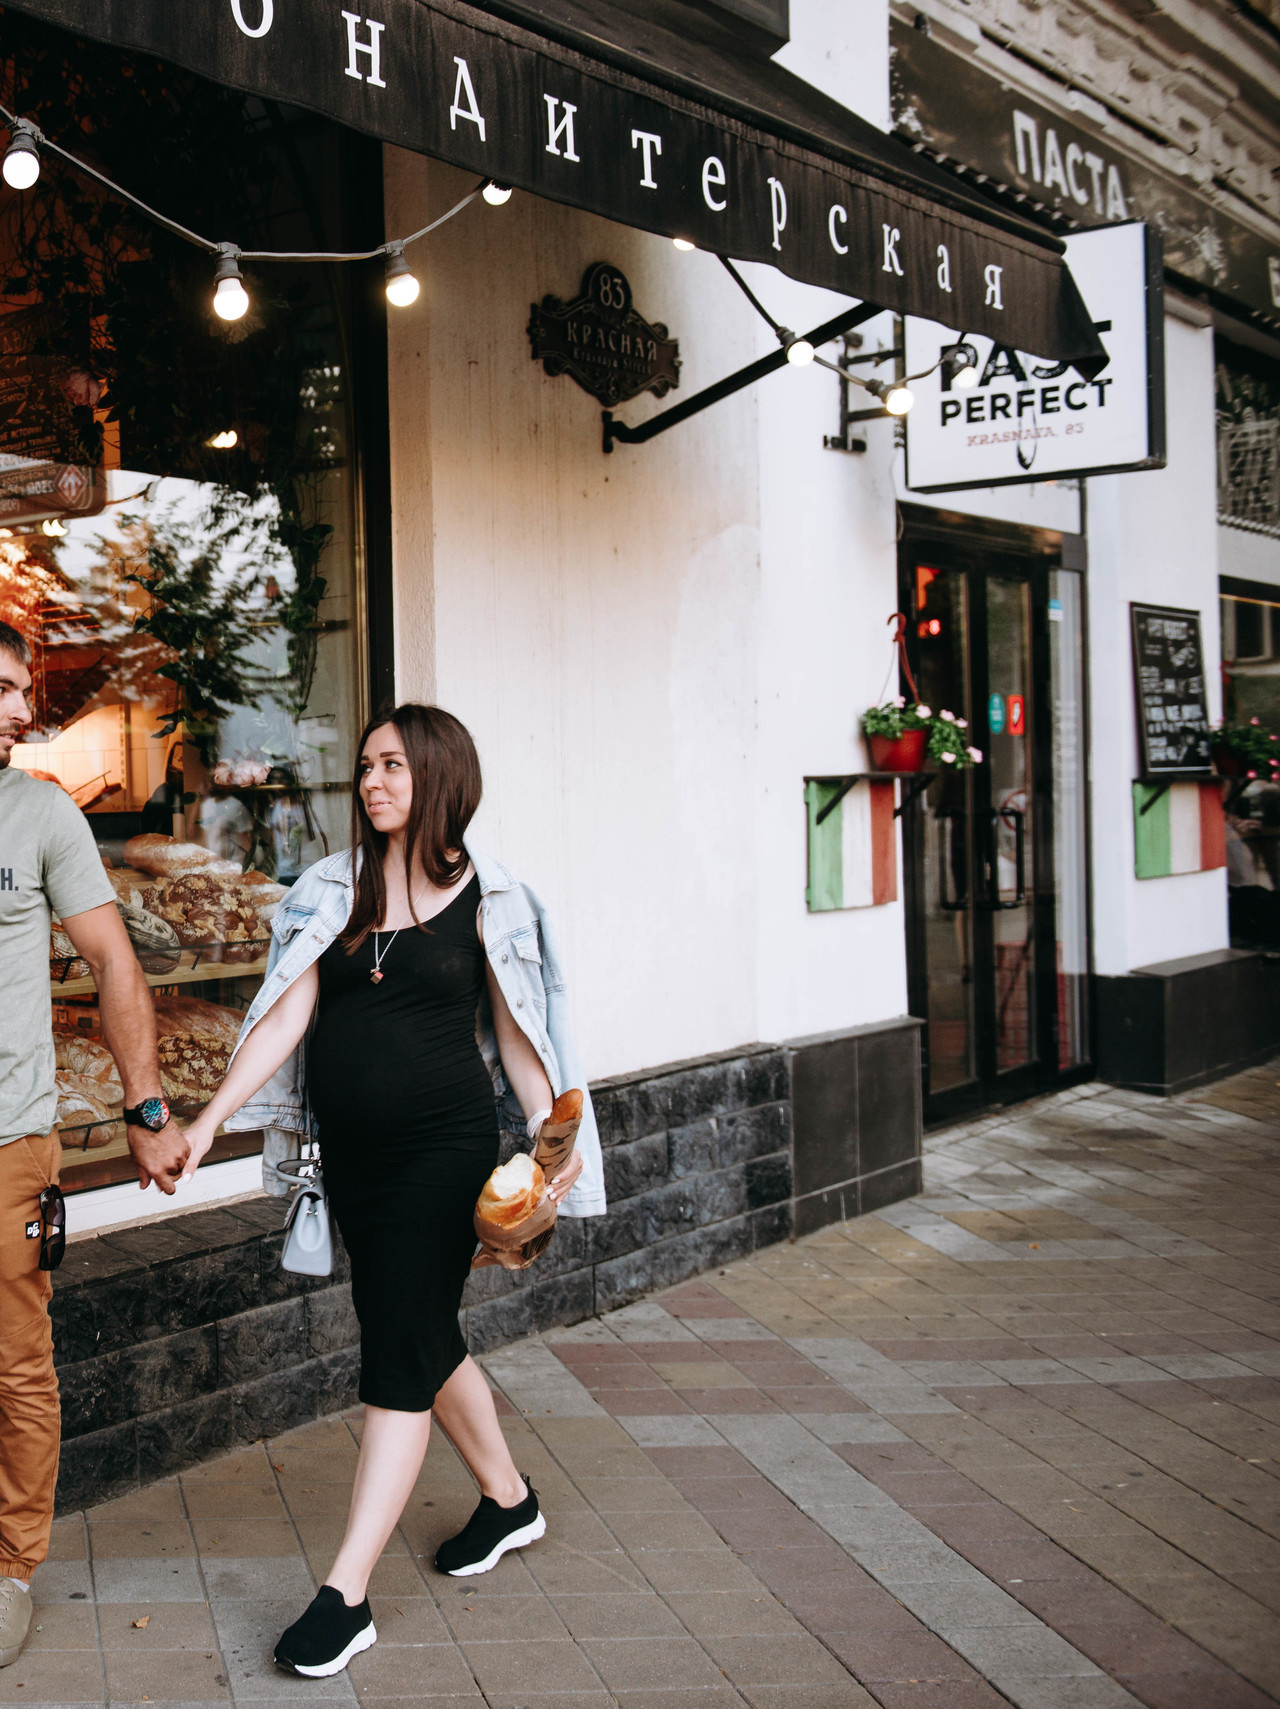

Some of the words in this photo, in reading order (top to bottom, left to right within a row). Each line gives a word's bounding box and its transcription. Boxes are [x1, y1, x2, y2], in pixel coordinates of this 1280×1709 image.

[1013, 109, 1129, 220] ПАСТА
[600, 273, 625, 309] 83
[567, 321, 658, 362] КРАСНАЯ
[940, 378, 1113, 427] PERFECT
